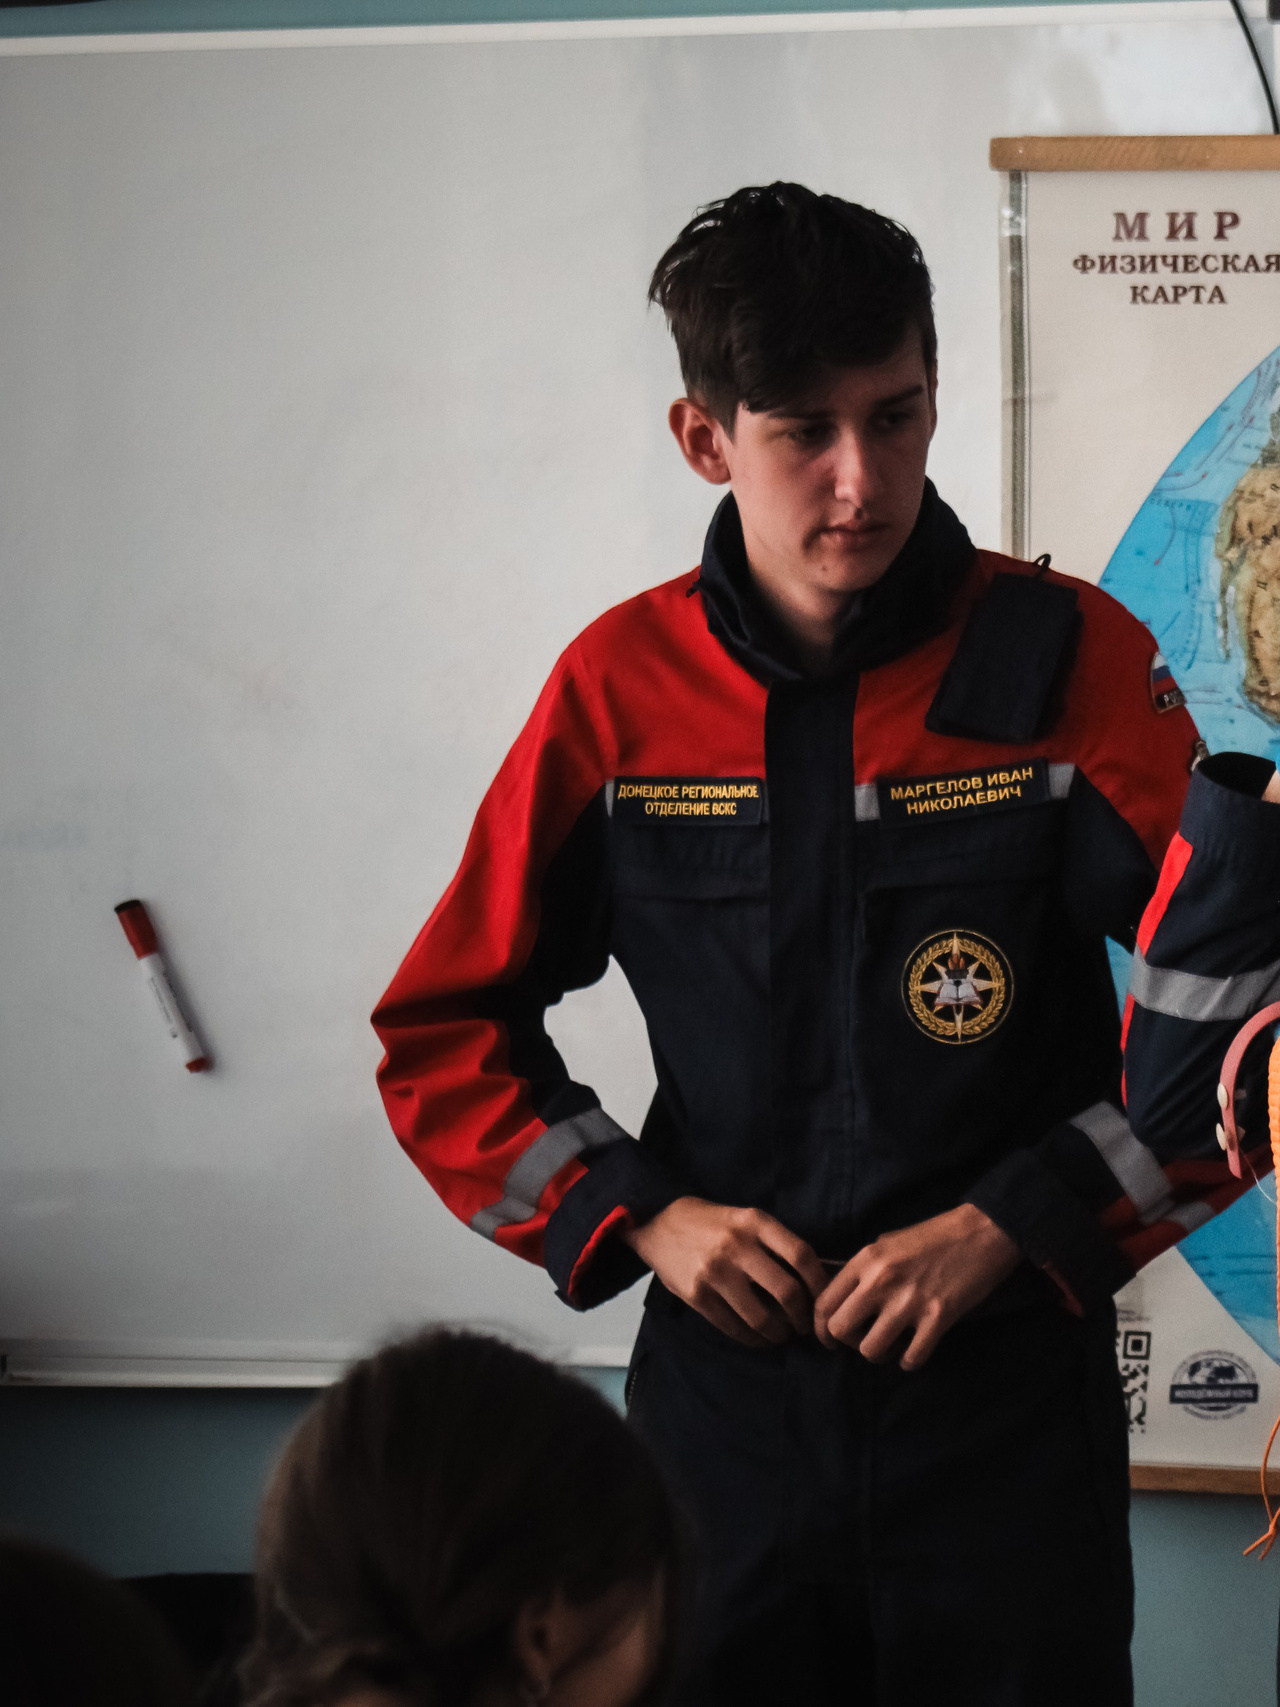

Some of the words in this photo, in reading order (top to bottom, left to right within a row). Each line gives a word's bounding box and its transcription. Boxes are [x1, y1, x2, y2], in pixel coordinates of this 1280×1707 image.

[1112, 210, 1241, 242] МИР
[1129, 284, 1228, 305] КАРТА
[618, 784, 679, 800] ДОНЕЦКОЕ
[681, 784, 759, 799] РЕГИОНАЛЬНОЕ
[890, 777, 983, 801] МАРГЕЛОВ
[987, 766, 1033, 787] ИВАН
[645, 802, 710, 817] ОТДЕЛЕНИЕ
[712, 802, 737, 816] ВСКС
[906, 785, 1022, 815] НИКОЛАЕВИЧ
